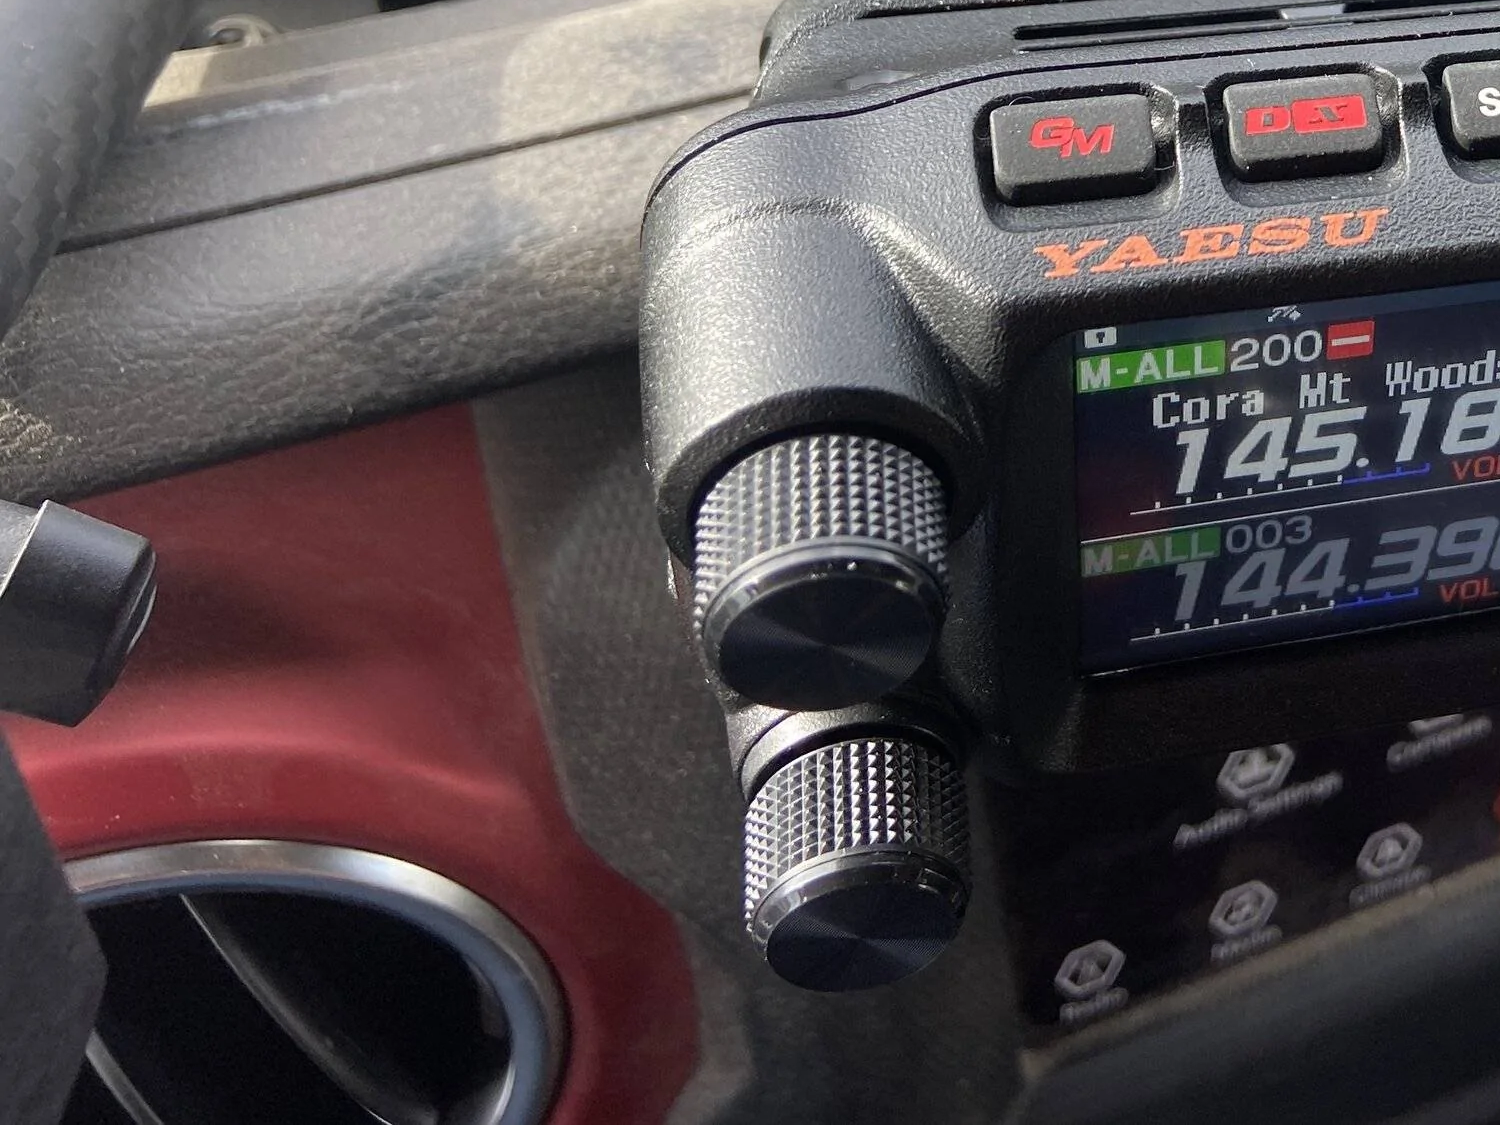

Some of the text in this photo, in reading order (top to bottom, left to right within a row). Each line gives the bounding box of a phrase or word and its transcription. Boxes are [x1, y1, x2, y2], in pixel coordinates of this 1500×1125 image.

[1029, 116, 1114, 157] GM
[1034, 208, 1390, 278] YAESU
[1081, 330, 1322, 390] M-ALL 200
[1153, 389, 1265, 428] Cora
[1083, 515, 1312, 575] M-ALL 003
[1438, 576, 1499, 604] VOL
